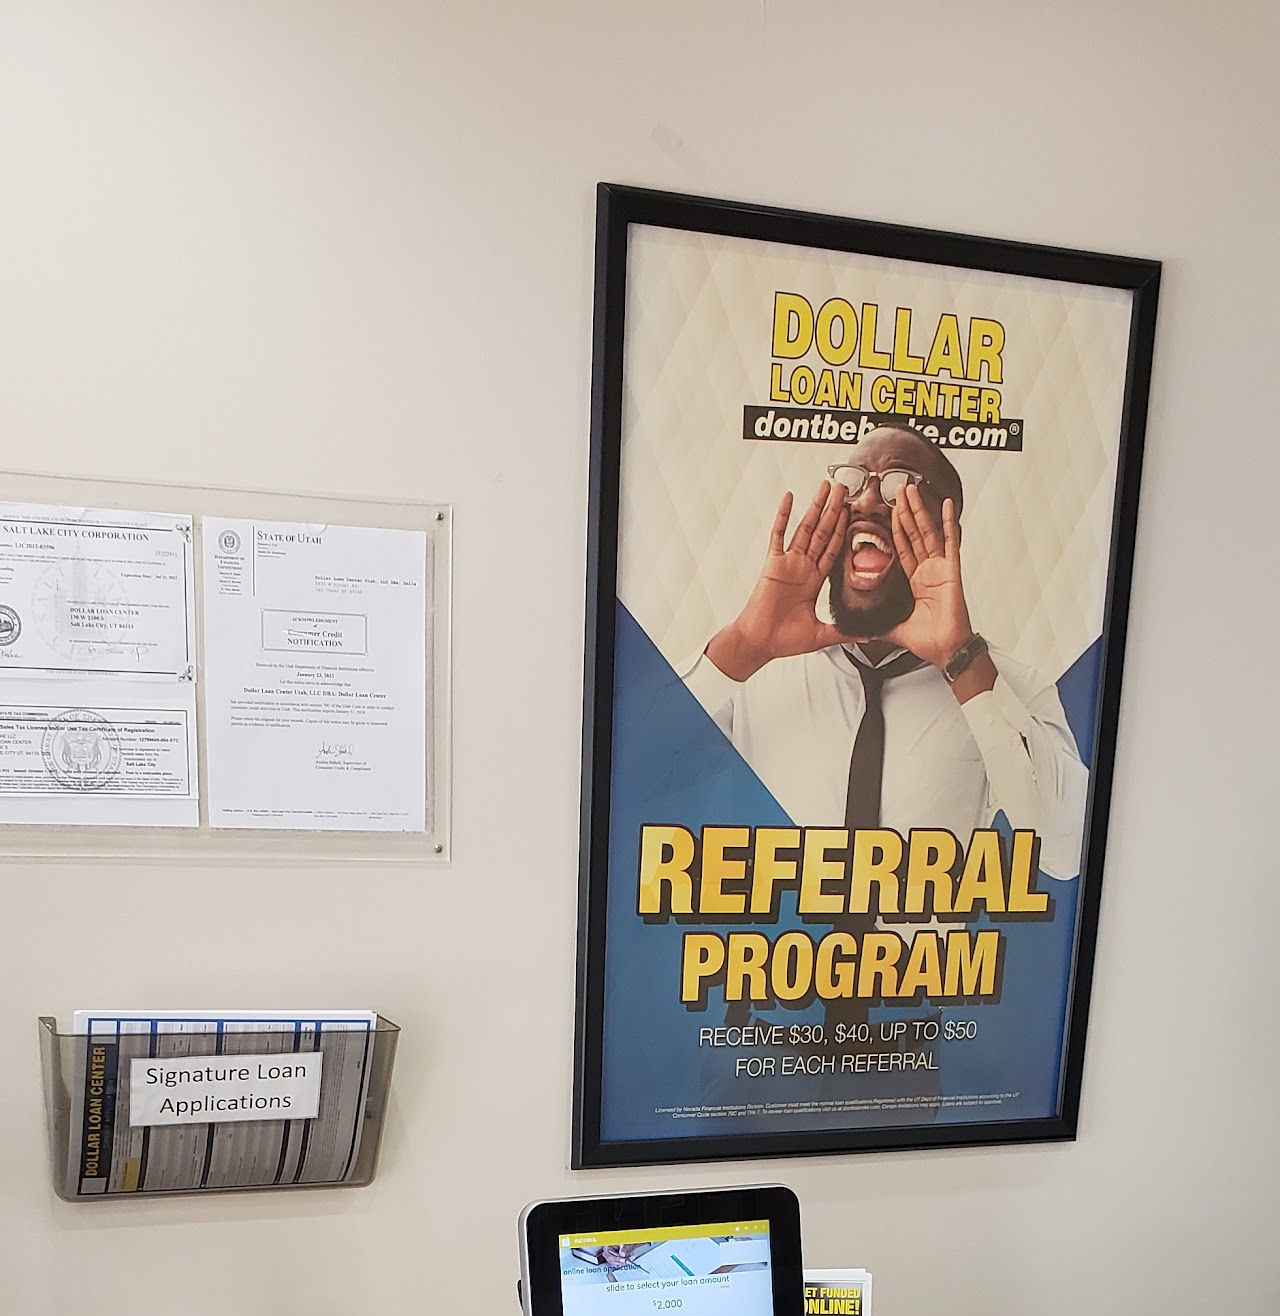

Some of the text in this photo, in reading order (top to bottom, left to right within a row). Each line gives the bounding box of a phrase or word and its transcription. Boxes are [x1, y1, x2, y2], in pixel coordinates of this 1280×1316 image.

[771, 291, 1005, 384] DOLLAR
[770, 363, 1001, 424] LOAN CENTER
[3, 525, 149, 541] SALT LAKE CITY CORPORATION
[257, 530, 322, 545] STATE OF UTAH
[287, 637, 343, 647] NOTIFICATION
[322, 630, 343, 639] Credit
[637, 824, 1053, 920] REFERRAL
[680, 930, 1004, 1008] PROGRAM
[699, 1019, 977, 1047] RECEIVE $30, $40, UP TO $50
[146, 1063, 307, 1088] Signature Loan
[735, 1051, 940, 1078] FOR EACH REFERRAL
[85, 1046, 106, 1177] DOLLAR LOAN CENTER
[159, 1091, 292, 1117] Applications
[563, 1263, 641, 1276] online loan application
[606, 1275, 730, 1293] slide to select your loan amount
[820, 1287, 861, 1299] FUNDED
[652, 1299, 683, 1311] $2,000
